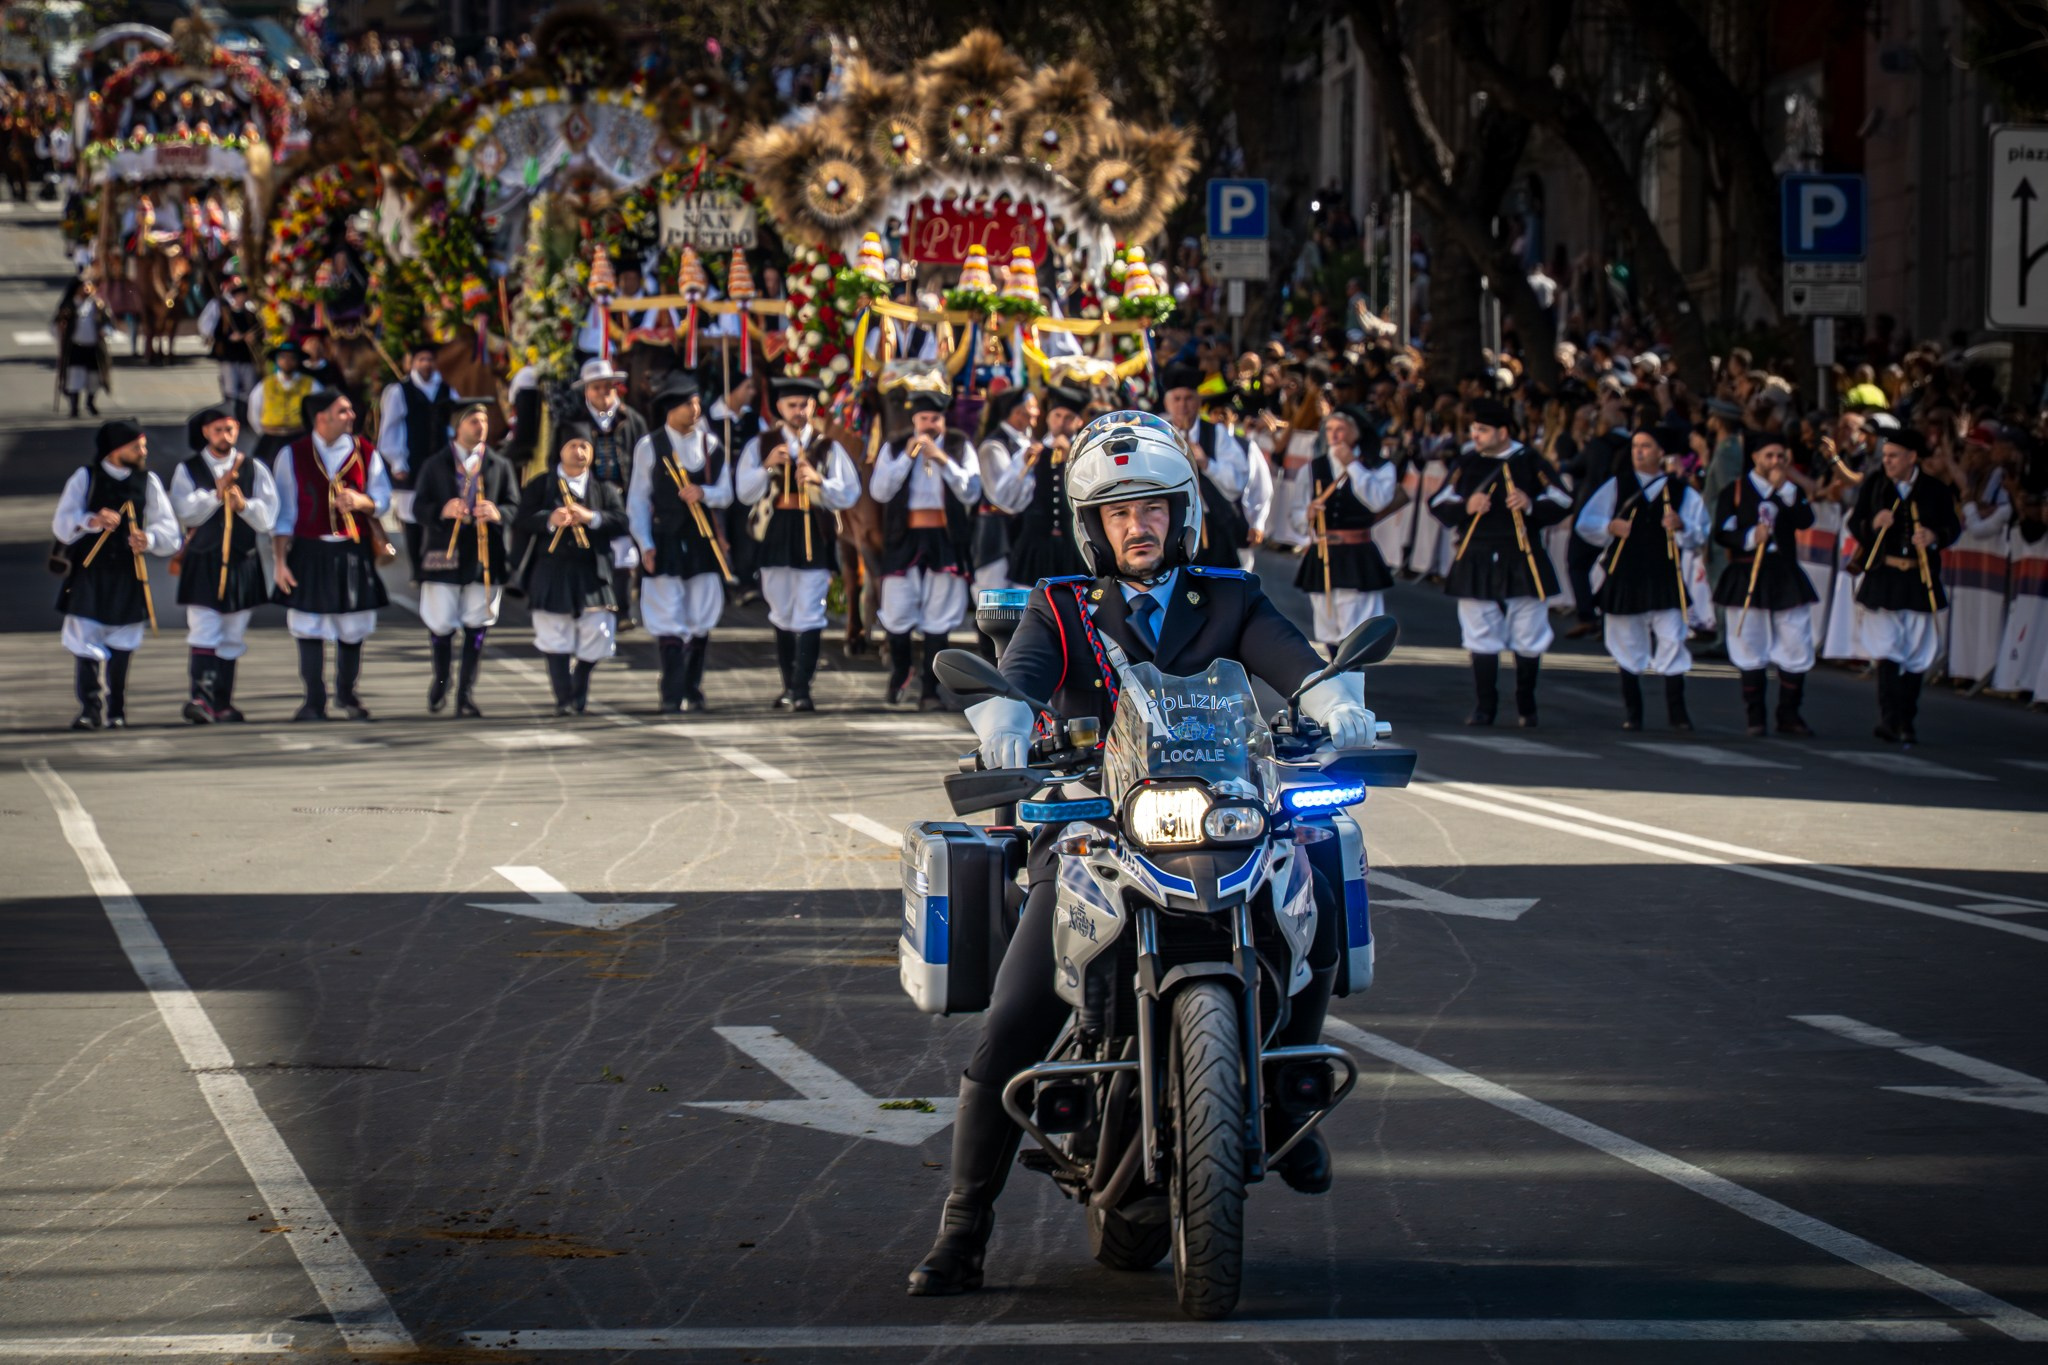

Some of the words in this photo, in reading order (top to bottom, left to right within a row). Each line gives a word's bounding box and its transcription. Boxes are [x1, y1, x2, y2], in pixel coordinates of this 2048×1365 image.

[1220, 186, 1256, 234] P
[1800, 183, 1847, 249] P
[683, 212, 731, 229] SAN
[666, 228, 753, 247] PIETRO
[1146, 694, 1232, 714] POLIZIA
[1161, 748, 1226, 763] LOCALE
